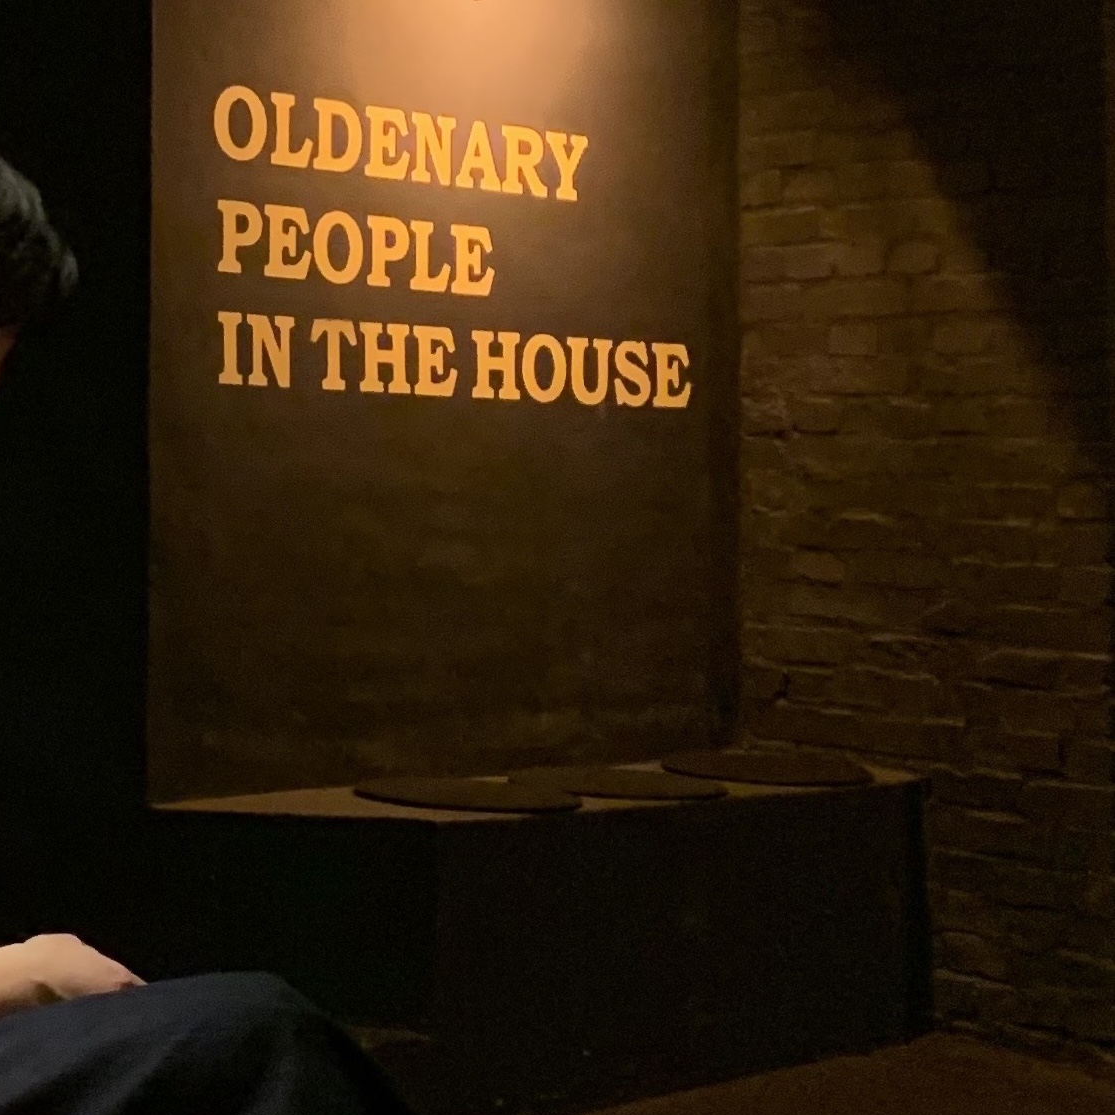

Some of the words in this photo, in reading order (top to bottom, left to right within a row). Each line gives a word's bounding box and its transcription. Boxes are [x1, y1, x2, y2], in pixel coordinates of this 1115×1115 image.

[213, 85, 589, 202] OLDENARY
[217, 199, 496, 297] PEOPLE
[218, 311, 295, 389] IN
[310, 318, 459, 397] THE
[471, 329, 692, 408] HOUSE
